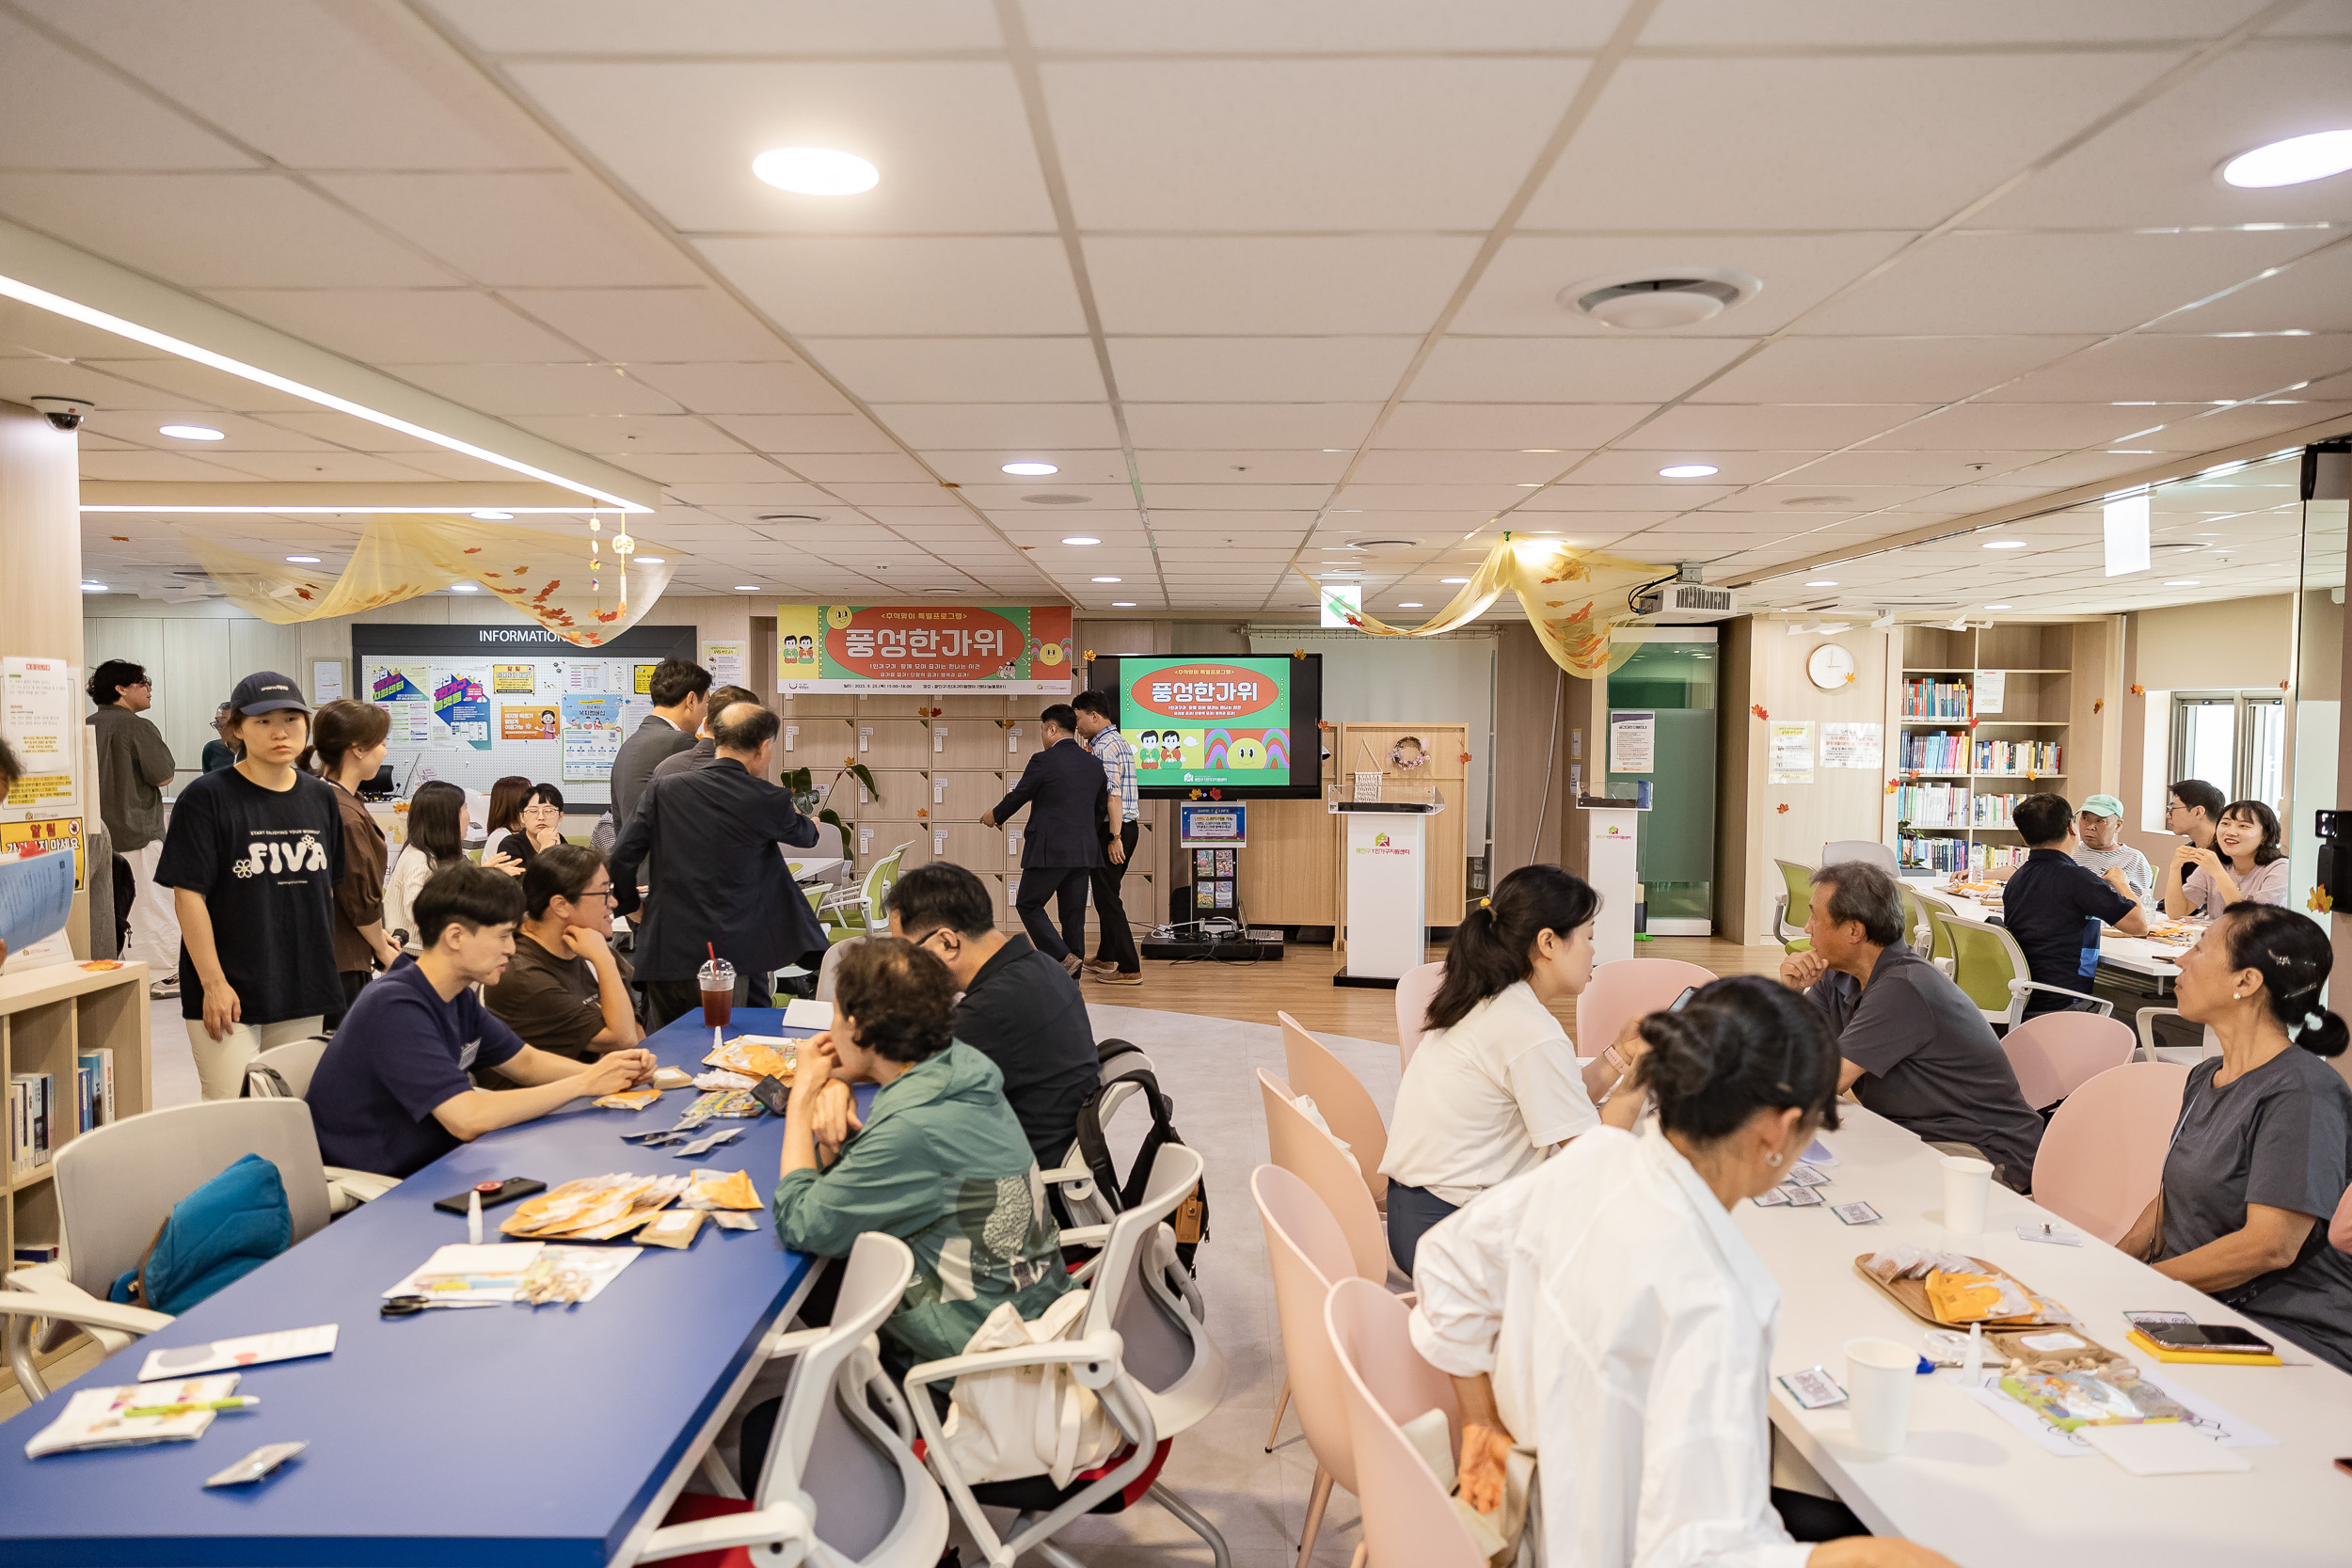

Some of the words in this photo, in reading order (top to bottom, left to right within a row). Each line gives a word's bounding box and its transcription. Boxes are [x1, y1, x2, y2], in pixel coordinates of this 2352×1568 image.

[845, 627, 1004, 658] 풍성한가위
[373, 680, 405, 702] 지원센터
[434, 678, 467, 702] 1인가구
[1152, 681, 1257, 703] 풍성한가위
[50, 836, 81, 852] 마세요
[247, 842, 327, 875] FIVA
